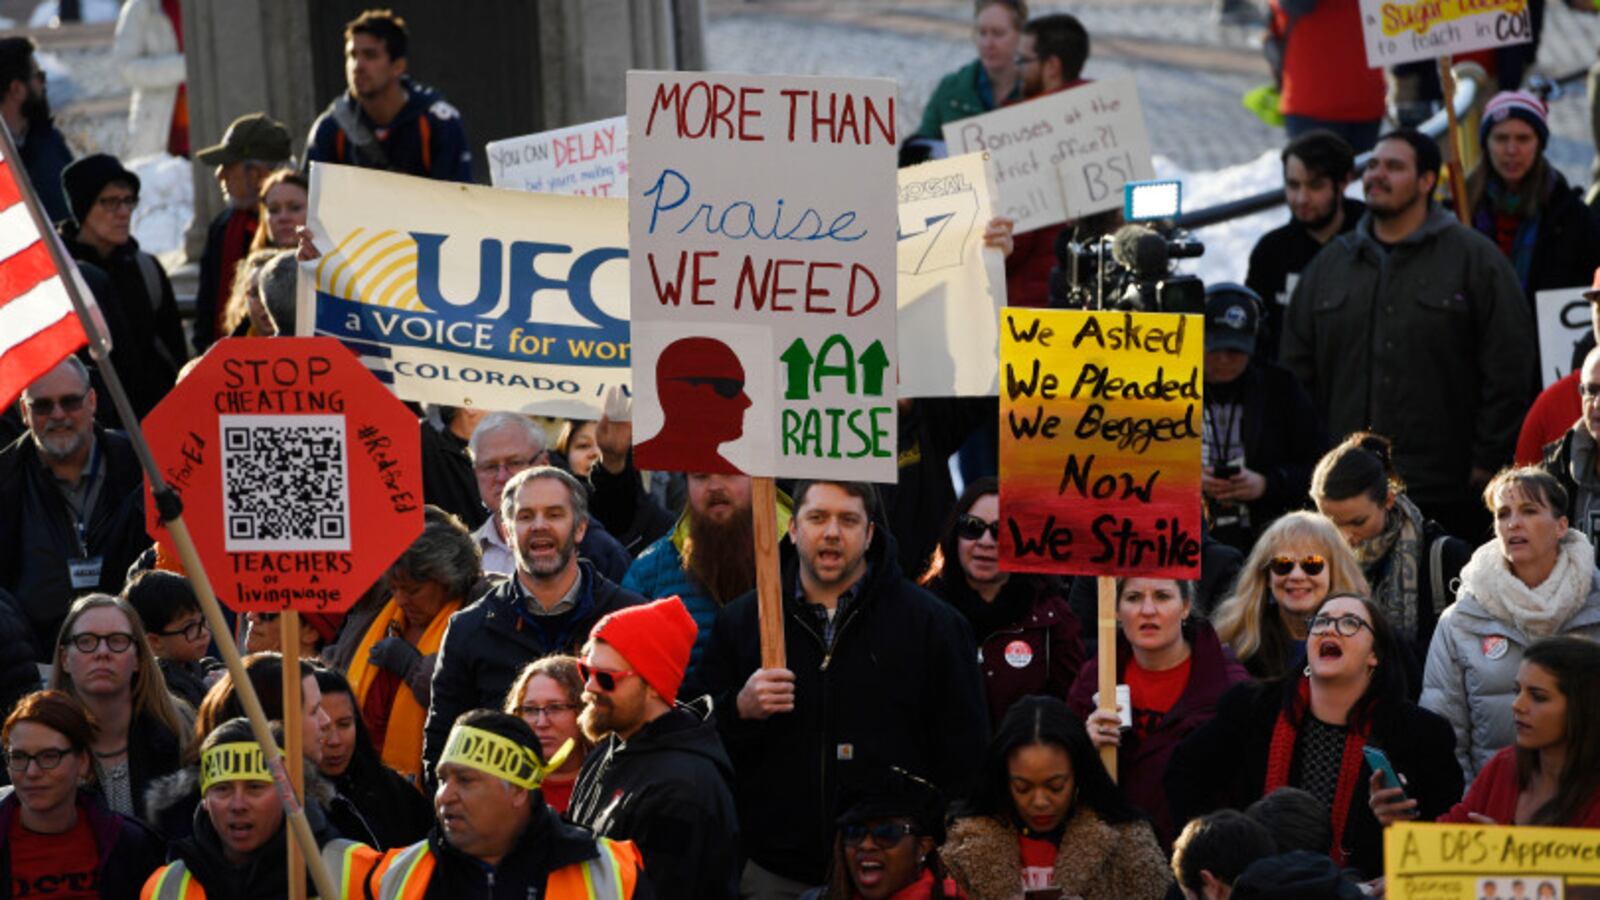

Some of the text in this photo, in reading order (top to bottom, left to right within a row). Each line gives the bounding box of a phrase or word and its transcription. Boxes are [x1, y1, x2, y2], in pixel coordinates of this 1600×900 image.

[1377, 9, 1531, 56] to teach in CO!
[1382, 0, 1442, 34] Sugar
[645, 81, 895, 145] MORE THAN
[959, 98, 1121, 154] Bonuses at the
[643, 169, 868, 241] Praise
[647, 251, 881, 317] WE NEED
[345, 313, 361, 331] a
[372, 311, 494, 350] VOICE
[509, 328, 556, 355] for
[1007, 315, 1055, 347] We
[1072, 313, 1186, 357] Asked
[223, 357, 332, 389] STOP
[394, 361, 580, 395] COLORADO
[814, 333, 857, 395] A
[1006, 358, 1059, 401] We
[214, 389, 345, 413] CHEATING
[782, 407, 892, 458] RAISE
[1009, 403, 1201, 454] We Begged
[357, 424, 418, 514] #RedforEd
[1058, 454, 1161, 503] Now
[226, 552, 353, 573] TEACHERS
[1008, 514, 1200, 568] We Strike
[1401, 830, 1422, 868] A
